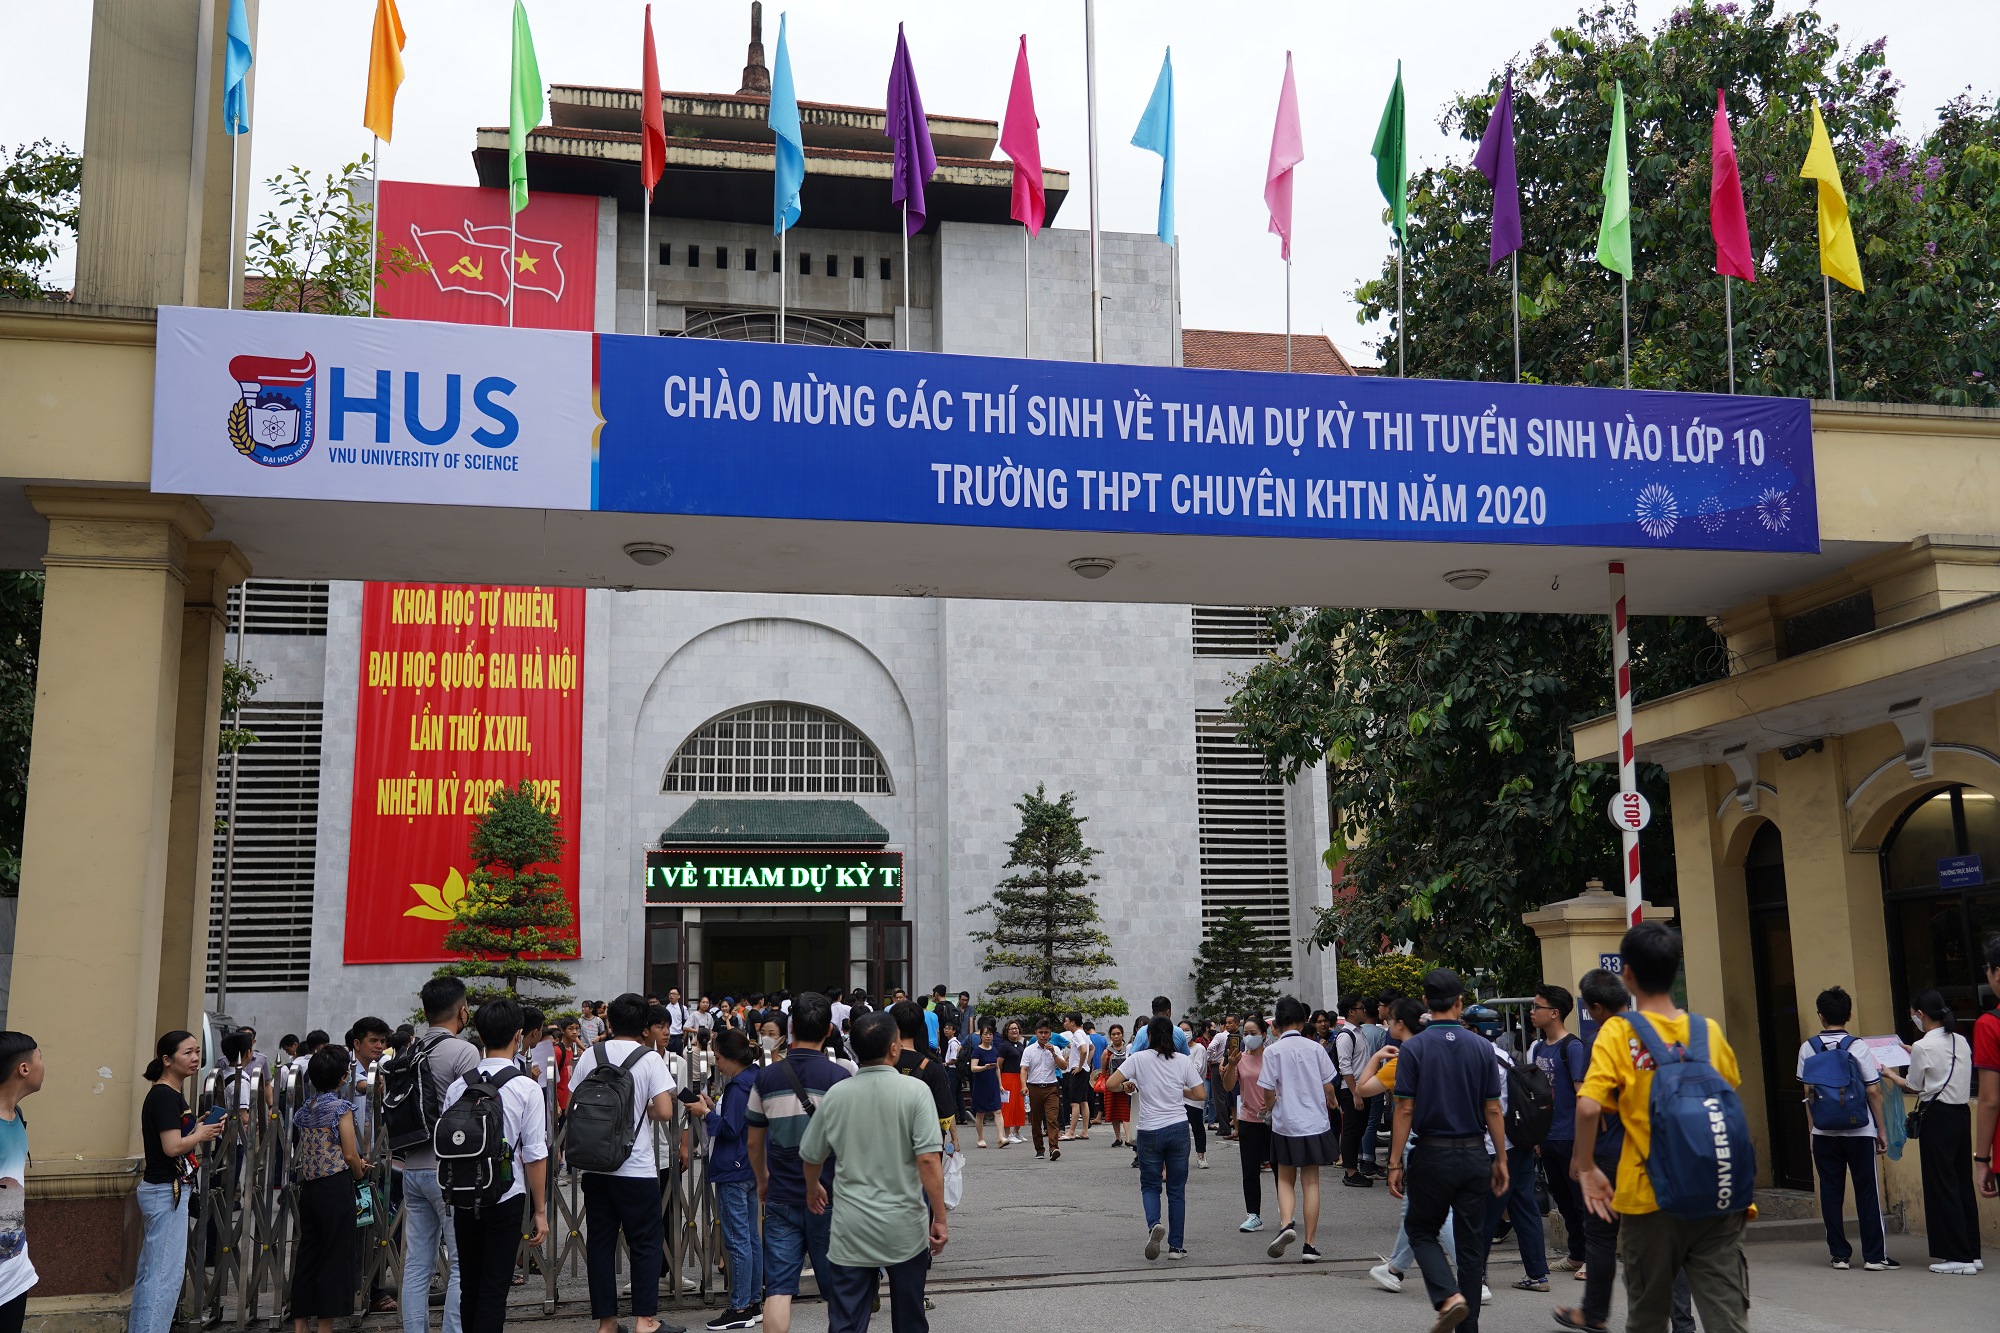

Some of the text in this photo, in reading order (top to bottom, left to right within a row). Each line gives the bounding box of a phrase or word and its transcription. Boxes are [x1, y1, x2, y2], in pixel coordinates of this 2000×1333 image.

[304, 388, 312, 408] NHIÊN
[305, 410, 313, 418] TỰ
[329, 367, 520, 449] HUS
[665, 368, 1764, 466] CHÀO MỪNG CÁC THÍ SINH VỀ THAM DỰ KỲ THI TUYỂN SINH VÀO LỚP 10
[262, 456, 276, 464] ĐẠI
[278, 454, 294, 464] HỌC
[294, 439, 310, 458] KHOA
[329, 448, 519, 472] VNU UNIVERSITY OF SCIENCE
[932, 457, 1546, 525] TRƯỜNG THPT CHUYÊN KHTN NĂM 2020
[392, 586, 557, 634] KHOA HỌC TỰ NHIÊN,
[369, 640, 576, 697] ĐẠI HỌC QUỐC GIA HÀ NỘI
[411, 702, 531, 756] LẦN THỨ XXVII,
[377, 771, 432, 823] NHIỆM
[438, 771, 460, 815] KỲ
[521, 779, 560, 815] 025
[1623, 793, 1641, 828] STOP
[660, 862, 698, 886] VỀ
[704, 867, 785, 887] THAM
[790, 864, 832, 892] DỰ
[836, 862, 874, 886] KỲ
[1708, 1108, 1732, 1210] CONVERSE
